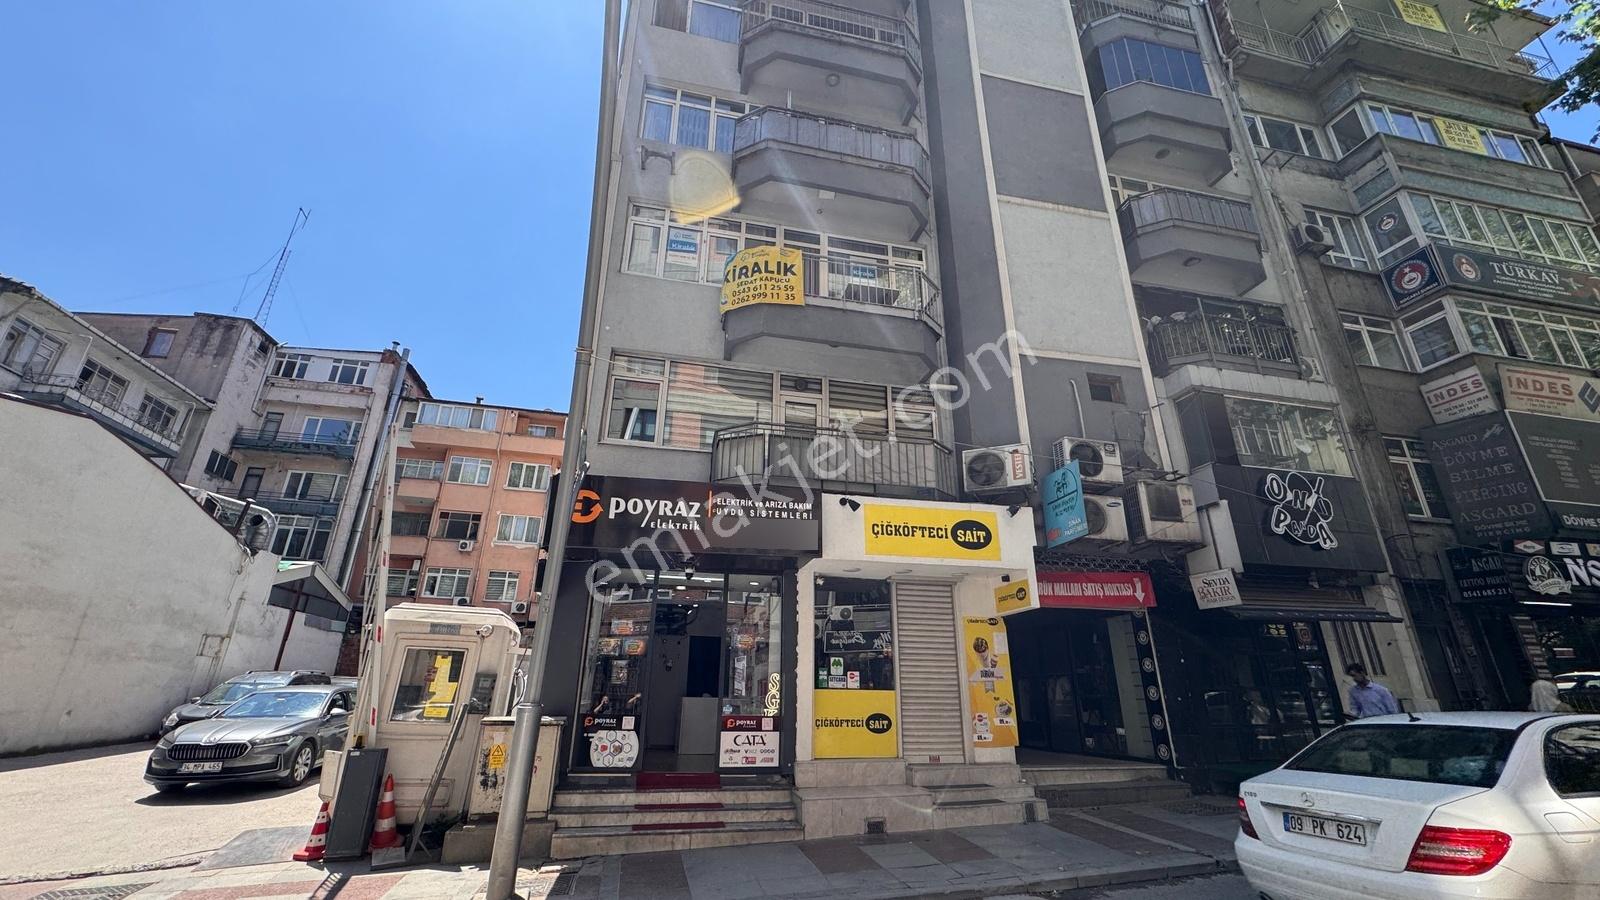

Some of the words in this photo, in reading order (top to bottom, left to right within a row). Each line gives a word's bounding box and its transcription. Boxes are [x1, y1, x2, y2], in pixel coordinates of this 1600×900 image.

[723, 260, 797, 283] KİRALIK
[732, 286, 751, 297] 0543
[753, 284, 768, 292] 611
[737, 279, 758, 288] SEDAT
[731, 295, 751, 306] 0262
[752, 292, 768, 300] 999
[785, 293, 796, 301] 35
[1427, 379, 1484, 404] INDES
[1507, 375, 1575, 397] INDES
[1443, 446, 1509, 467] DÖVME
[1449, 463, 1516, 483] SİLME
[717, 497, 754, 507] ELEKTRİK
[765, 500, 788, 509] ARIZA
[788, 502, 812, 510] BAKIM
[609, 497, 702, 527] POYRAZ
[716, 507, 745, 516] UYDU
[750, 508, 813, 520] SİSTEMLERİ
[1459, 502, 1536, 523] ASGARD
[872, 520, 949, 540] ÇİĞKÖFTECİ
[957, 528, 986, 543] SAİT
[1054, 582, 1083, 596] MALLARI
[1083, 583, 1103, 598] SATIŞ
[1103, 583, 1133, 596] NOKTASI
[1202, 577, 1230, 588] SEVDA
[1197, 586, 1232, 598] BAKIR
[815, 713, 864, 731] ÇİĞKÖFTECİ
[869, 715, 888, 729] SAİT
[733, 734, 767, 746] CATA
[1289, 816, 1303, 831] 09
[1312, 820, 1327, 835] PK
[1337, 823, 1361, 842] 624
